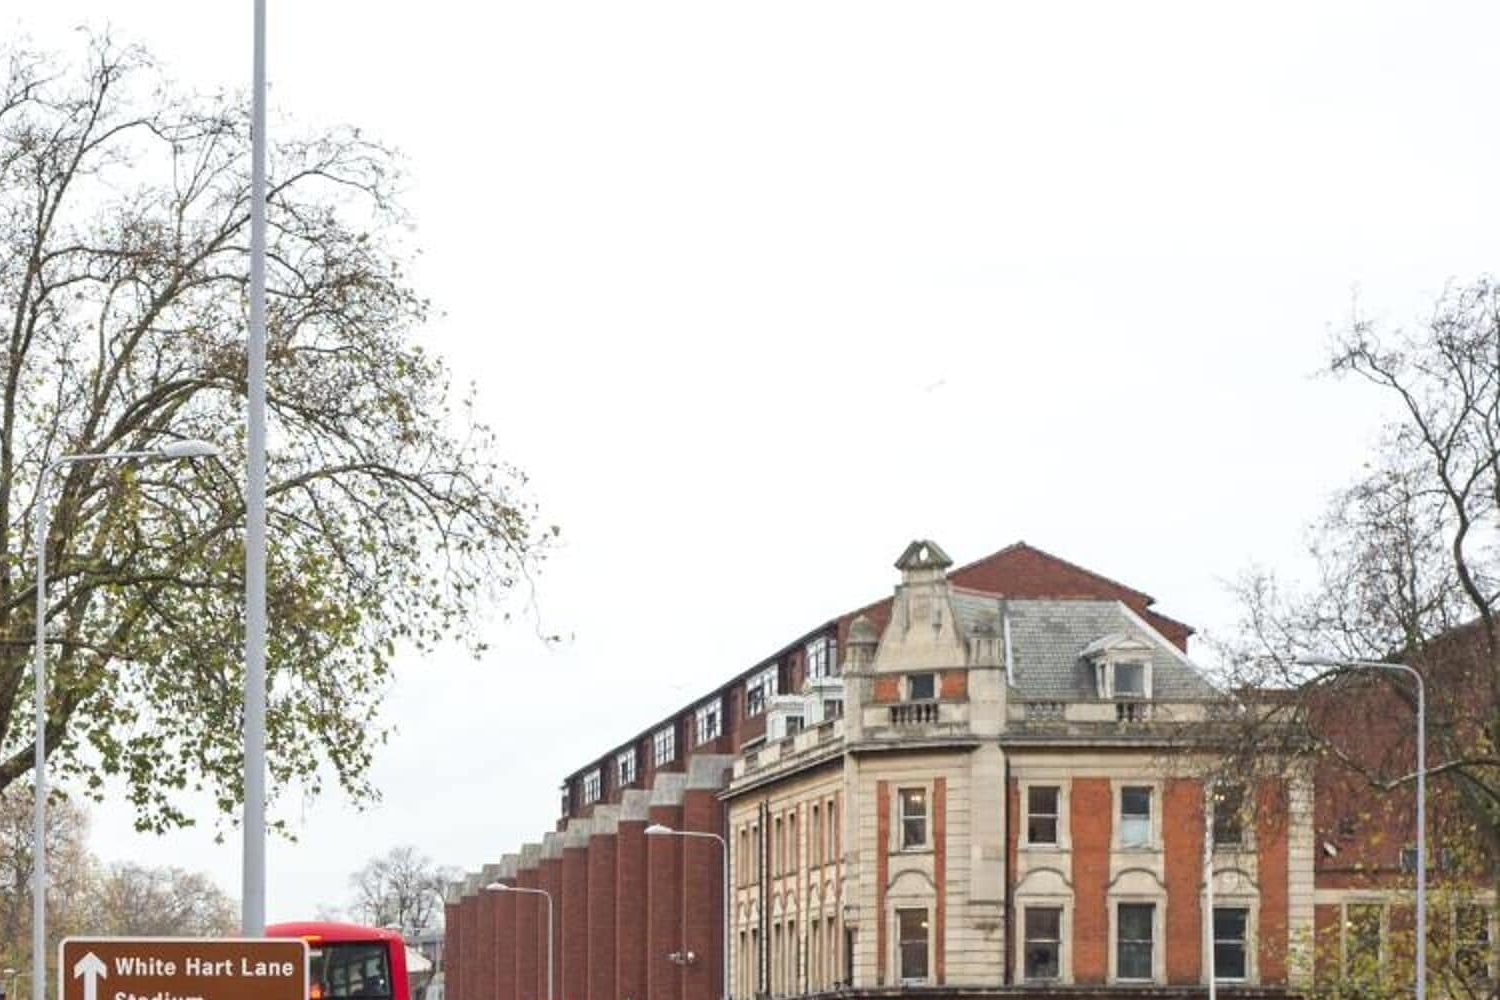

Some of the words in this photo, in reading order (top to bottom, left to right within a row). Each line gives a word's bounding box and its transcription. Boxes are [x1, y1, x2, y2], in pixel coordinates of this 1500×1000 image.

[115, 957, 177, 977] White
[185, 957, 233, 977] Hart
[241, 957, 294, 977] Lane
